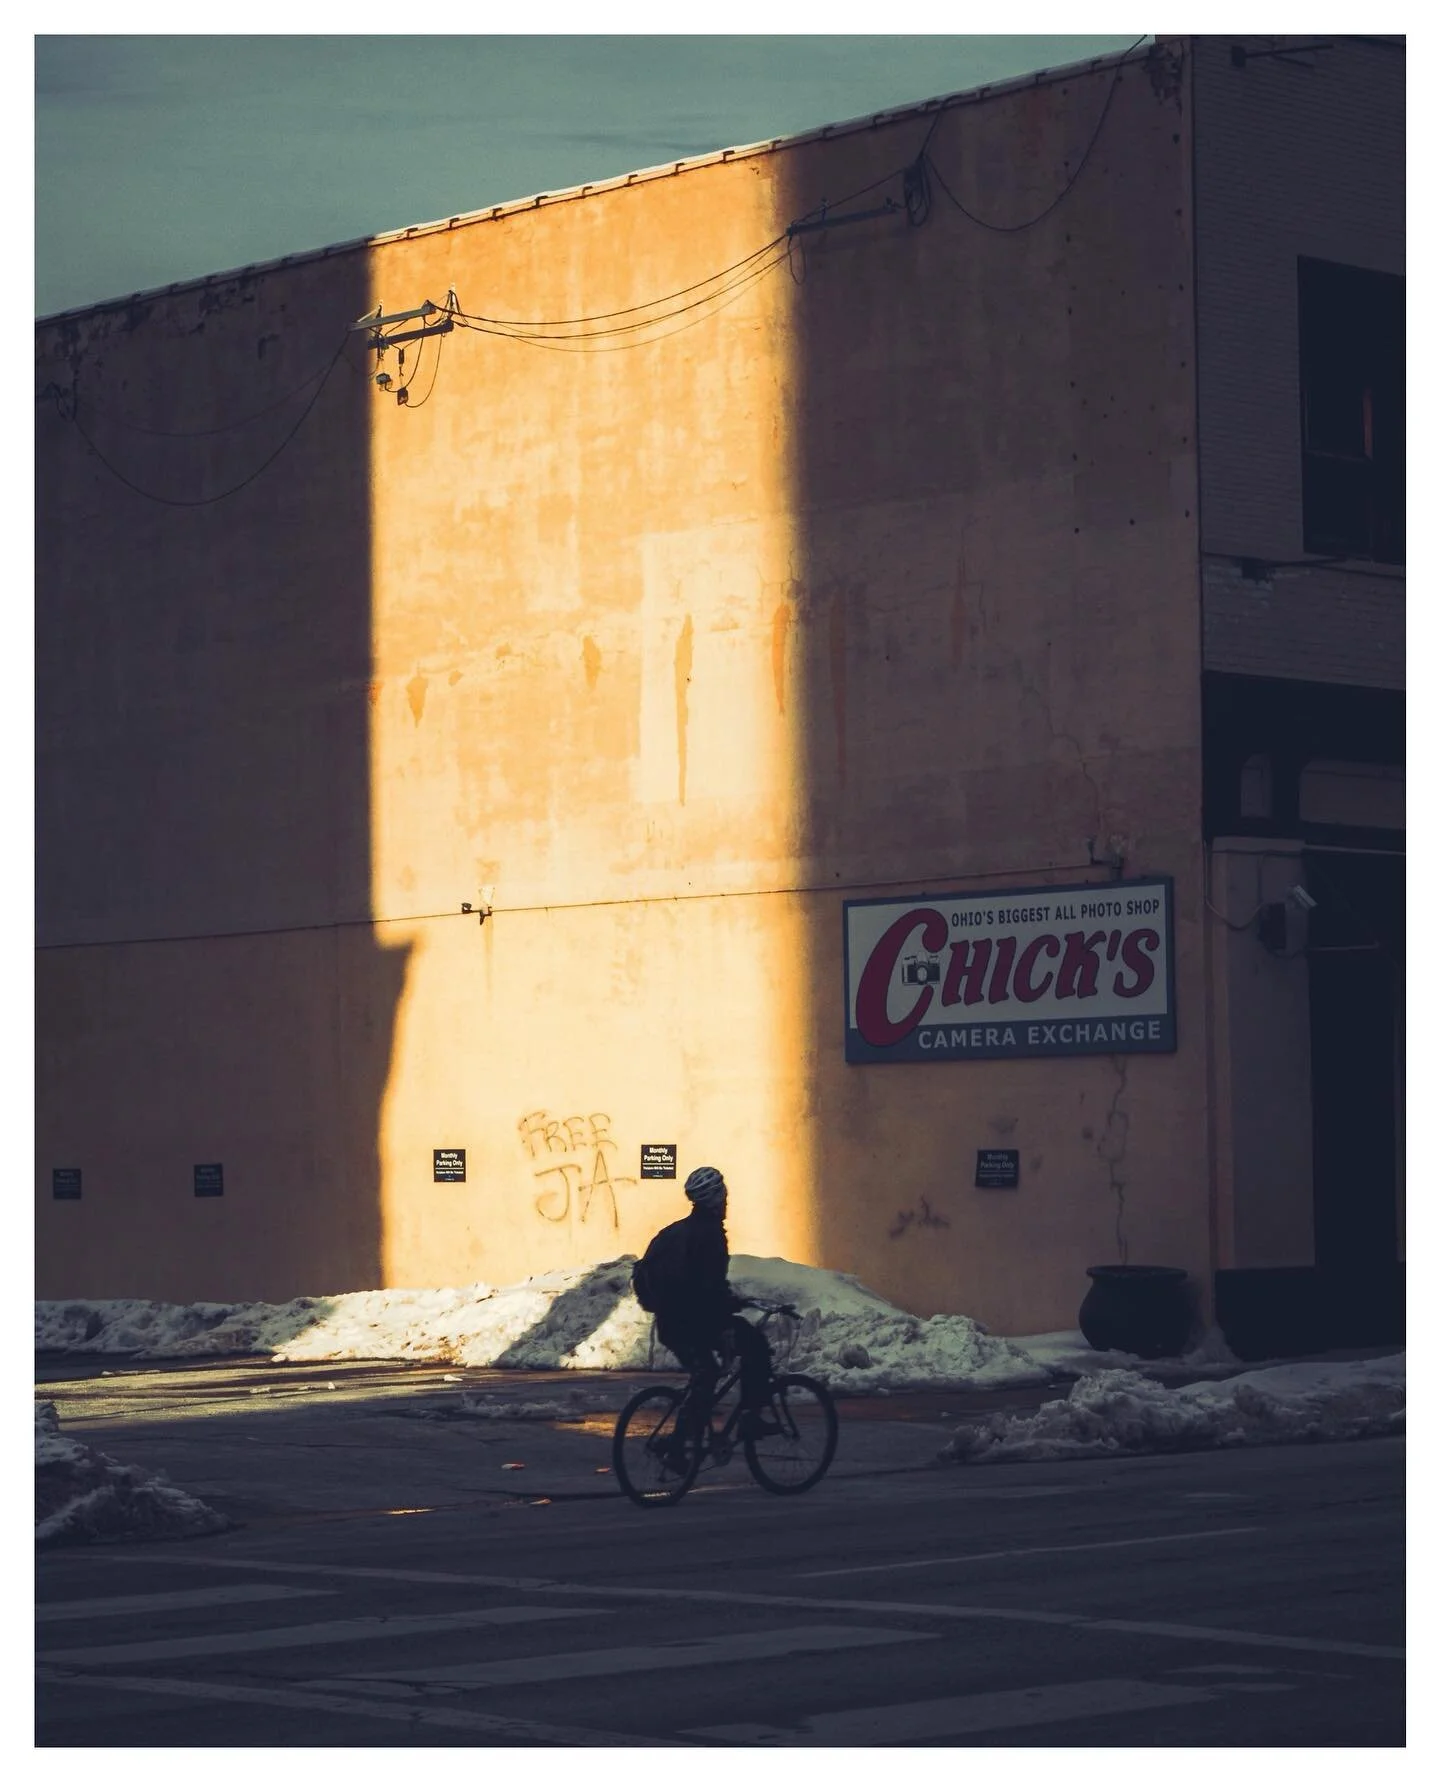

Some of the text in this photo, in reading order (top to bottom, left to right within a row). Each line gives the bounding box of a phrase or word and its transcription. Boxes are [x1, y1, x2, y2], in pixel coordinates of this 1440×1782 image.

[951, 899, 1160, 927] OHIO'S BIGGEST ALL PHOTO SHOP
[855, 907, 1160, 1047] CHICK'S
[918, 1020, 1161, 1049] CAMERA EXCHANGE
[517, 1111, 618, 1160] FREE
[435, 1159, 463, 1167] Parking Only
[643, 1154, 674, 1162] Parking Only
[649, 1147, 668, 1155] Monthly
